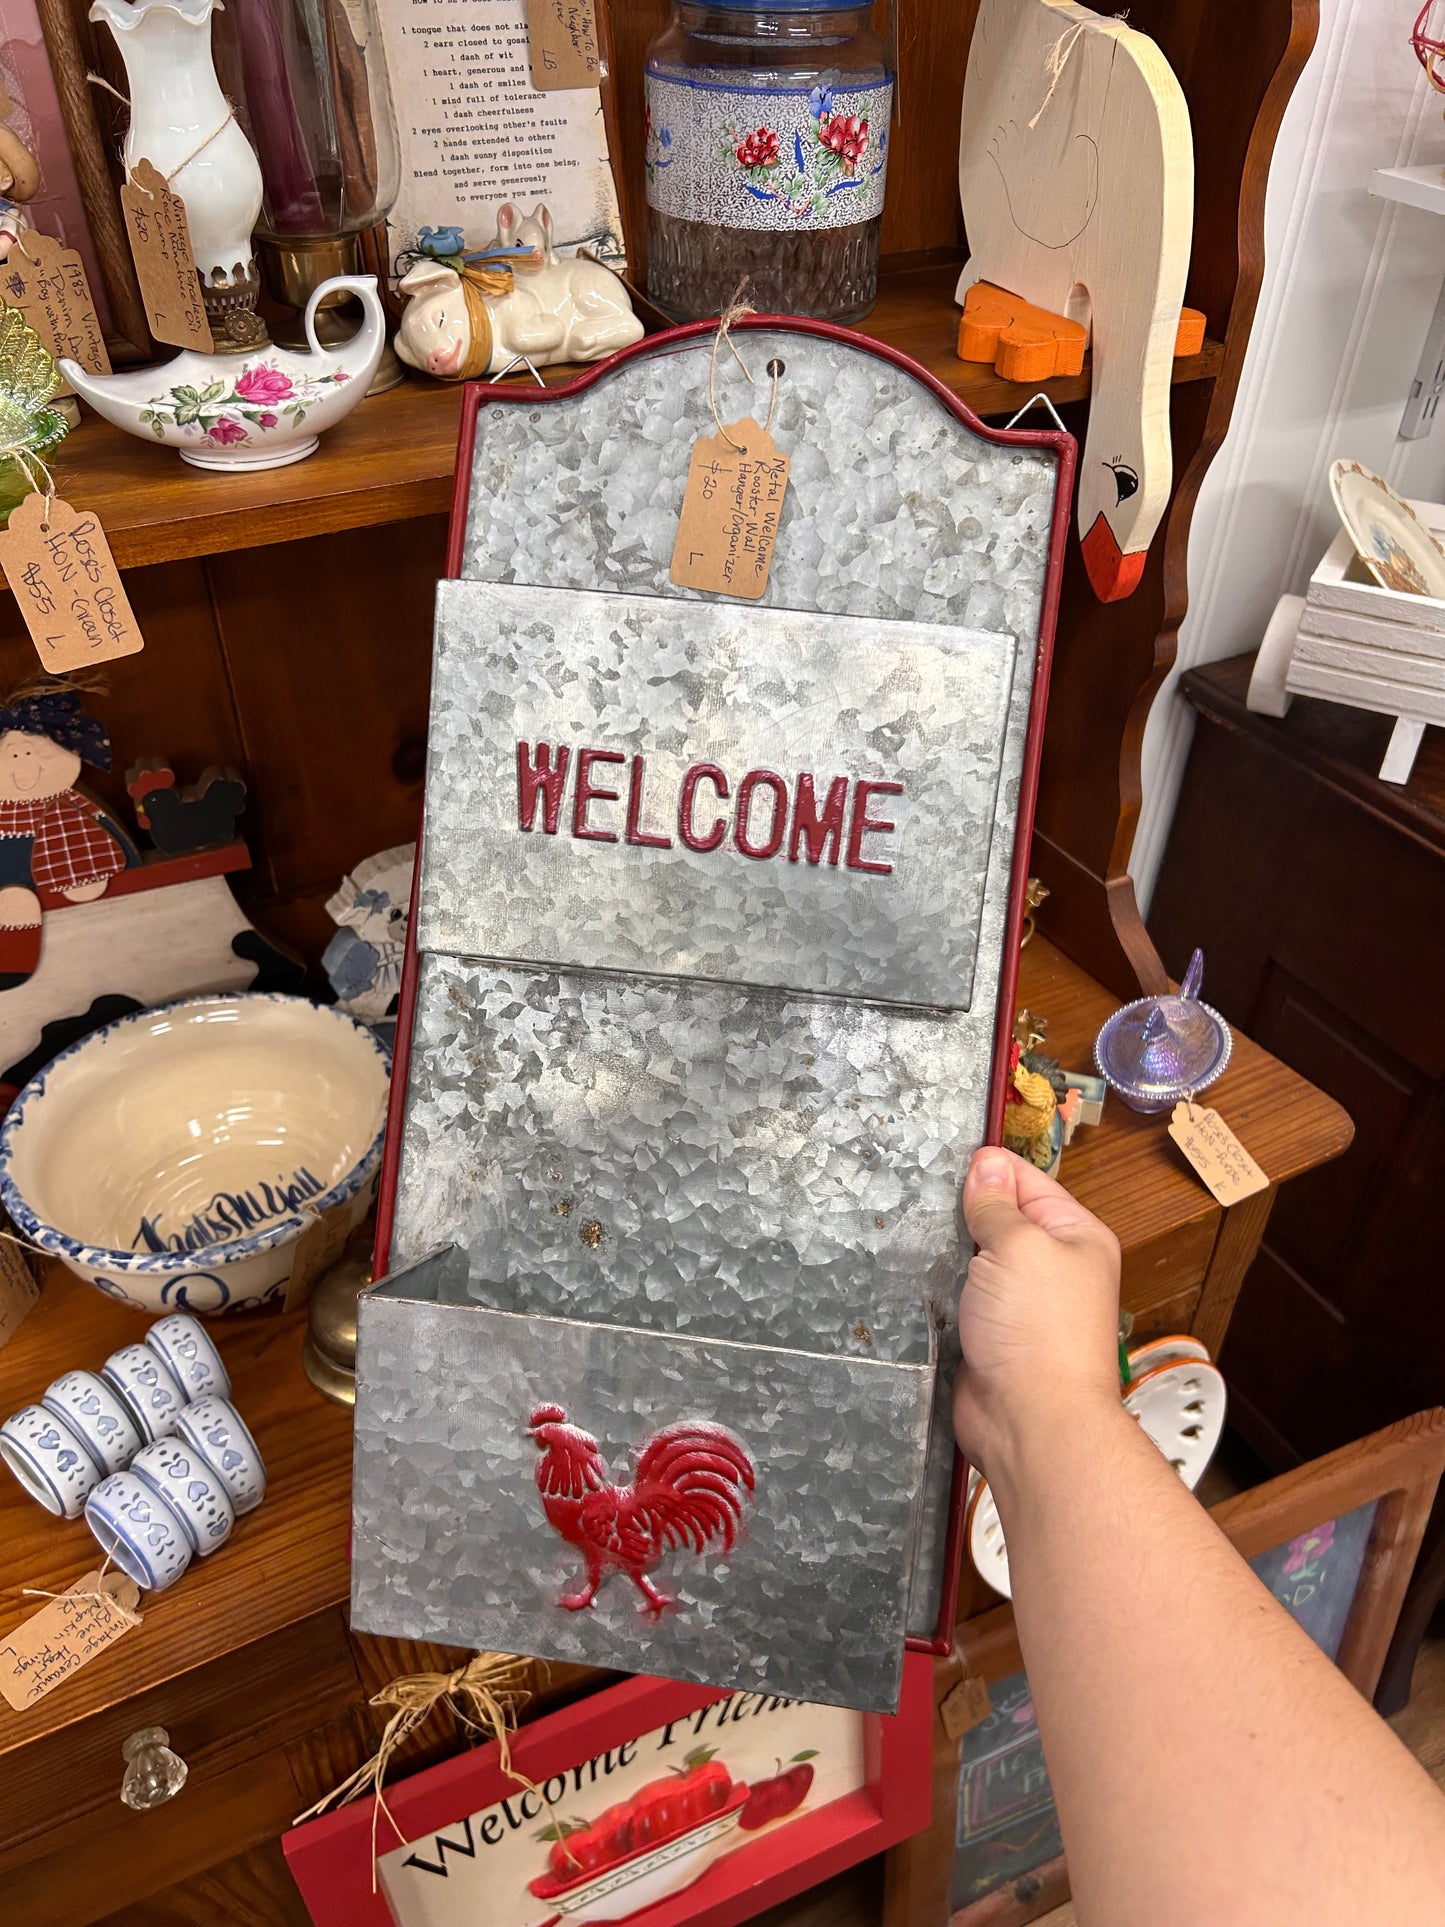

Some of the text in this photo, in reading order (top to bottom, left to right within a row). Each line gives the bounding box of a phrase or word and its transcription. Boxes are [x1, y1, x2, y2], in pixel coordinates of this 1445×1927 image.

[411, 27, 441, 35] tongue
[477, 108, 534, 116] cheerfulness
[504, 91, 546, 100] tolerance
[445, 123, 498, 132] overlooking
[471, 136, 509, 145] extended
[413, 169, 438, 177] Blend
[442, 167, 484, 176] together,
[501, 148, 552, 157] disposition
[500, 176, 546, 185] generously
[154, 212, 169, 260] Lamp
[160, 188, 172, 226] Rose
[185, 310, 198, 332] Oil
[173, 199, 205, 330] Vintage Porcelain
[50, 266, 73, 328] Denim
[62, 263, 103, 372] 1985 Vintage
[722, 462, 752, 584] Hanger/Organizer
[743, 460, 771, 553] Rooster Wall
[754, 458, 786, 579] Metal Welcome
[44, 532, 78, 582] HON
[689, 552, 704, 565] L
[21, 562, 66, 650] $55 L
[93, 587, 128, 643] Closet
[517, 740, 904, 874] WELCOME
[76, 1606, 111, 1639] Blue
[0, 1646, 17, 1656] L
[12, 1645, 51, 1676] Rings
[27, 1654, 81, 1698] Ceramic
[402, 1736, 640, 1879] Welcome
